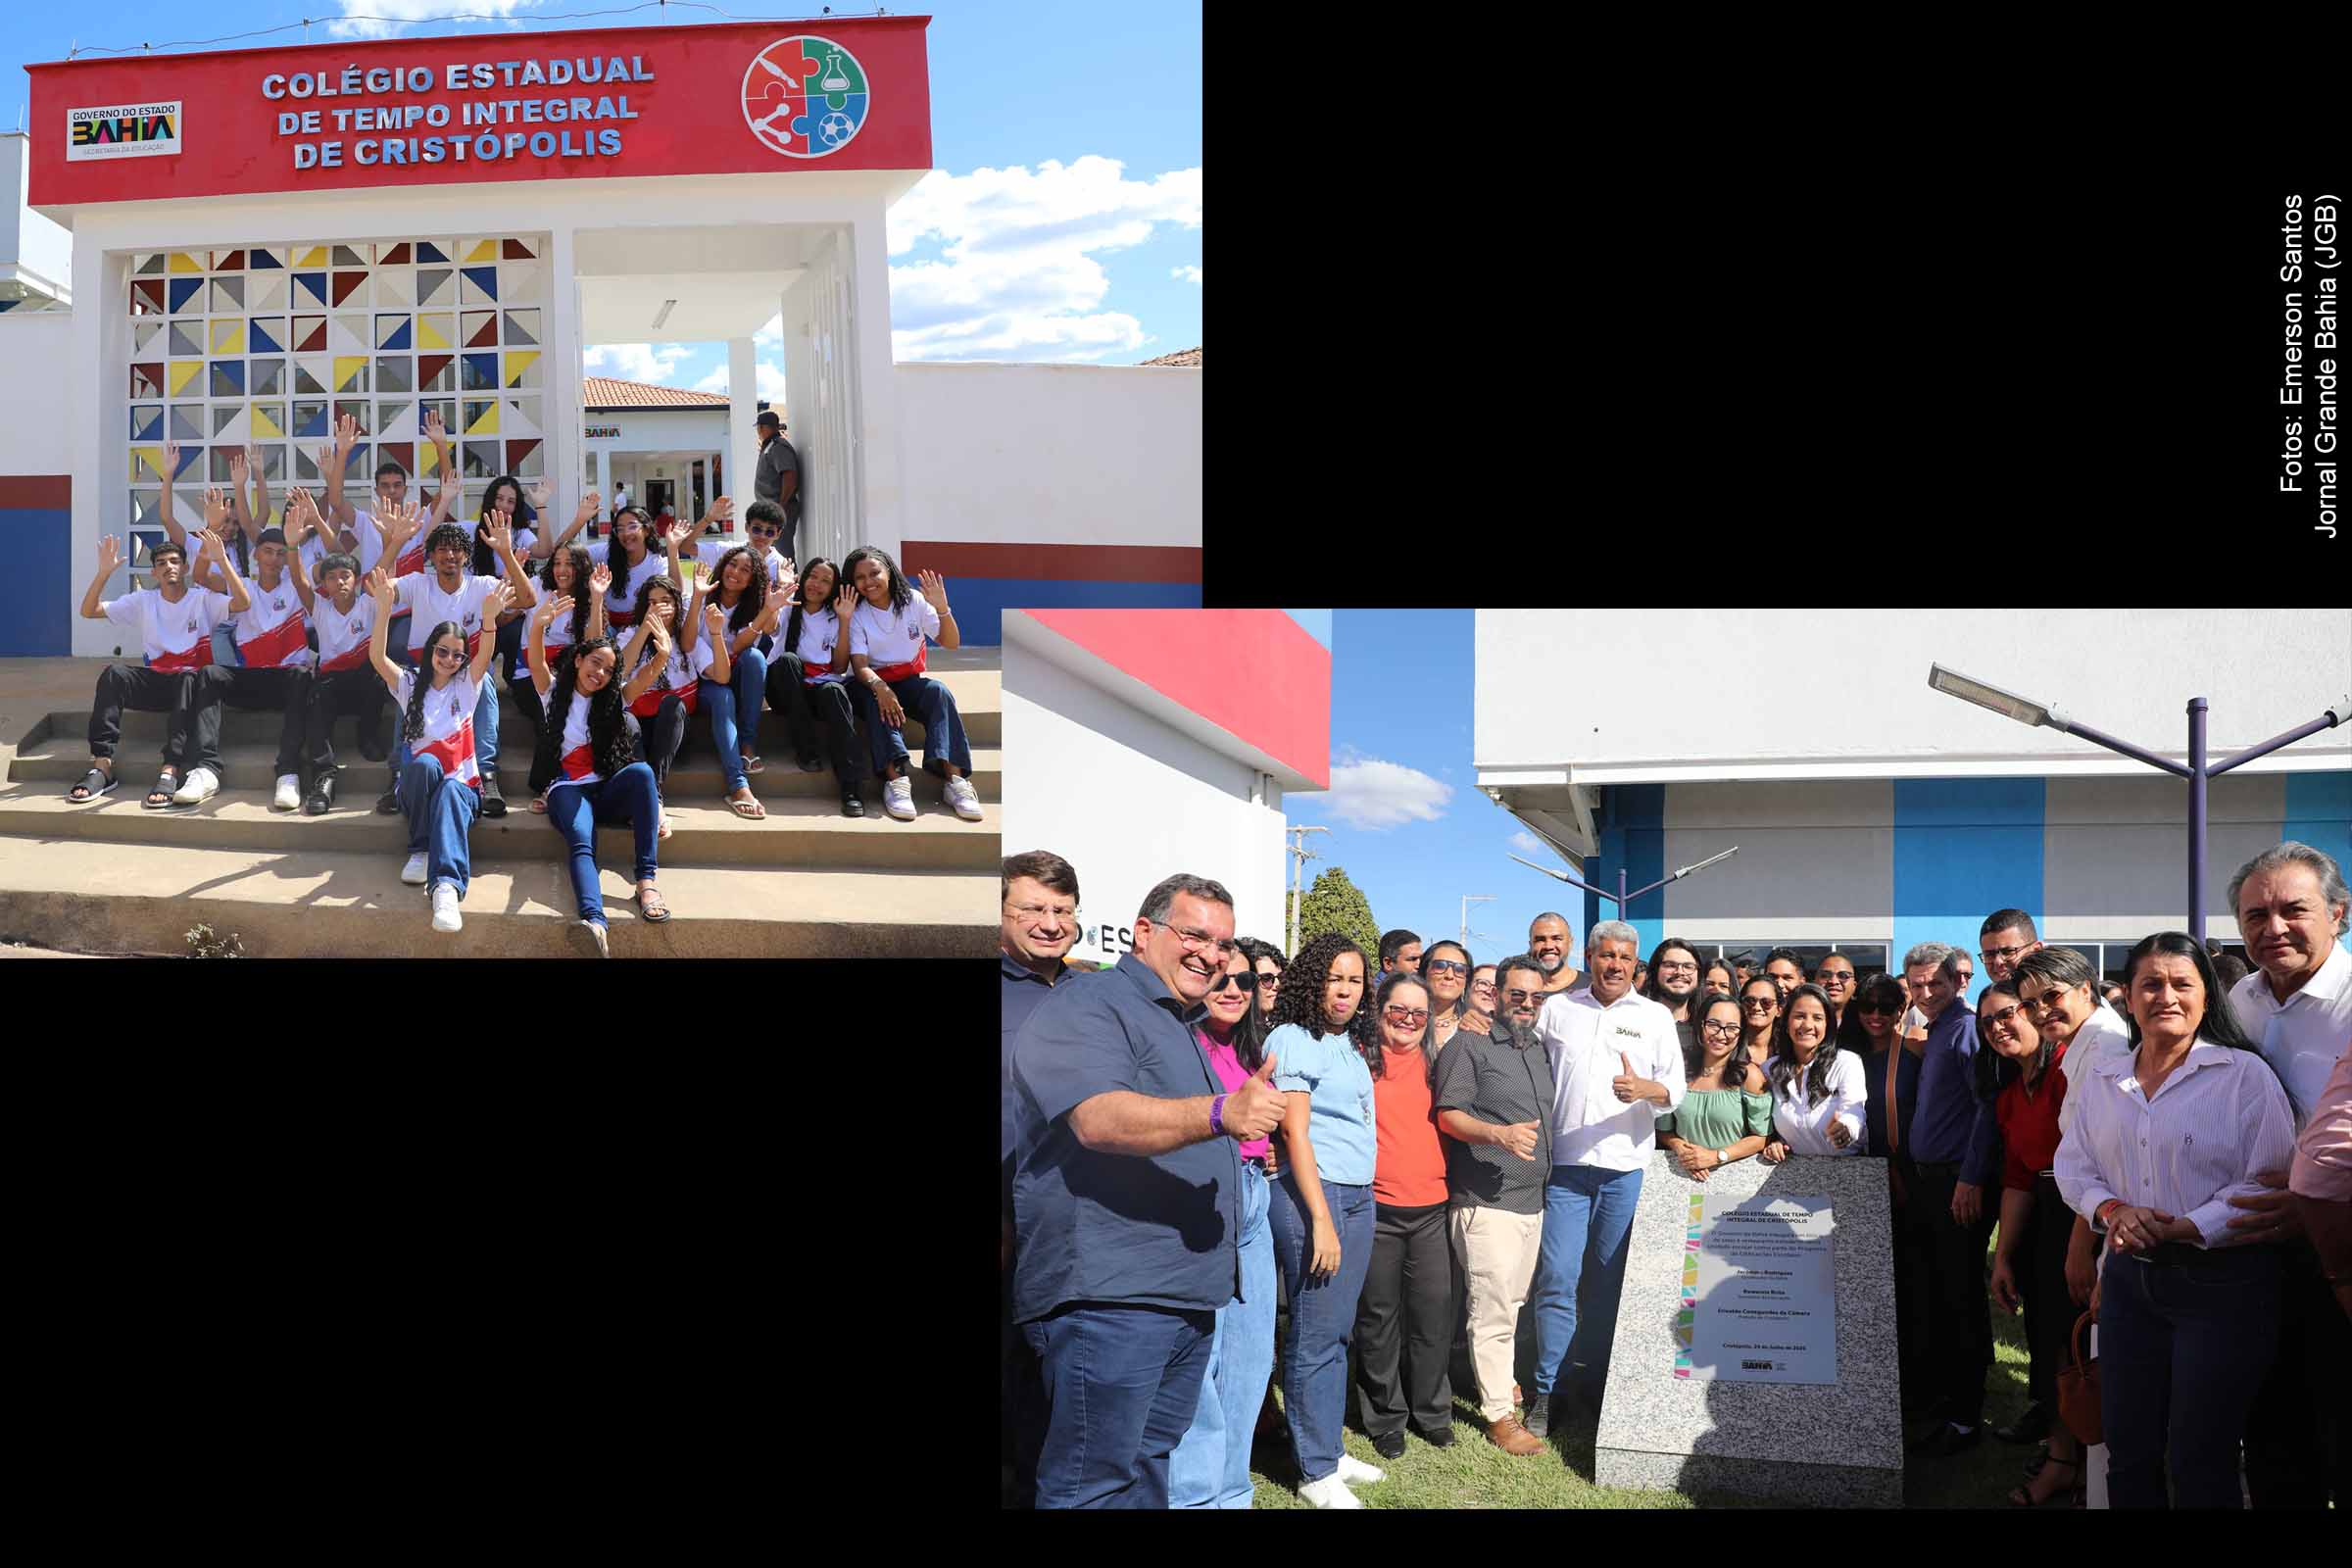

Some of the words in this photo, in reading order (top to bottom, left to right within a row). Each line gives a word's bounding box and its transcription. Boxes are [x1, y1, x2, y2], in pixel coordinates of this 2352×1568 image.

[262, 63, 434, 100] COLÉGIO
[446, 55, 655, 90] ESTADUAL
[73, 109, 120, 121] GOVERNO
[122, 108, 136, 117] DO
[138, 105, 175, 116] ESTADO
[278, 110, 322, 136] DE
[331, 103, 451, 132] TEMPO
[462, 95, 639, 126] INTEGRAL
[294, 140, 343, 170] DE
[354, 128, 622, 167] CRISTÓPOLIS
